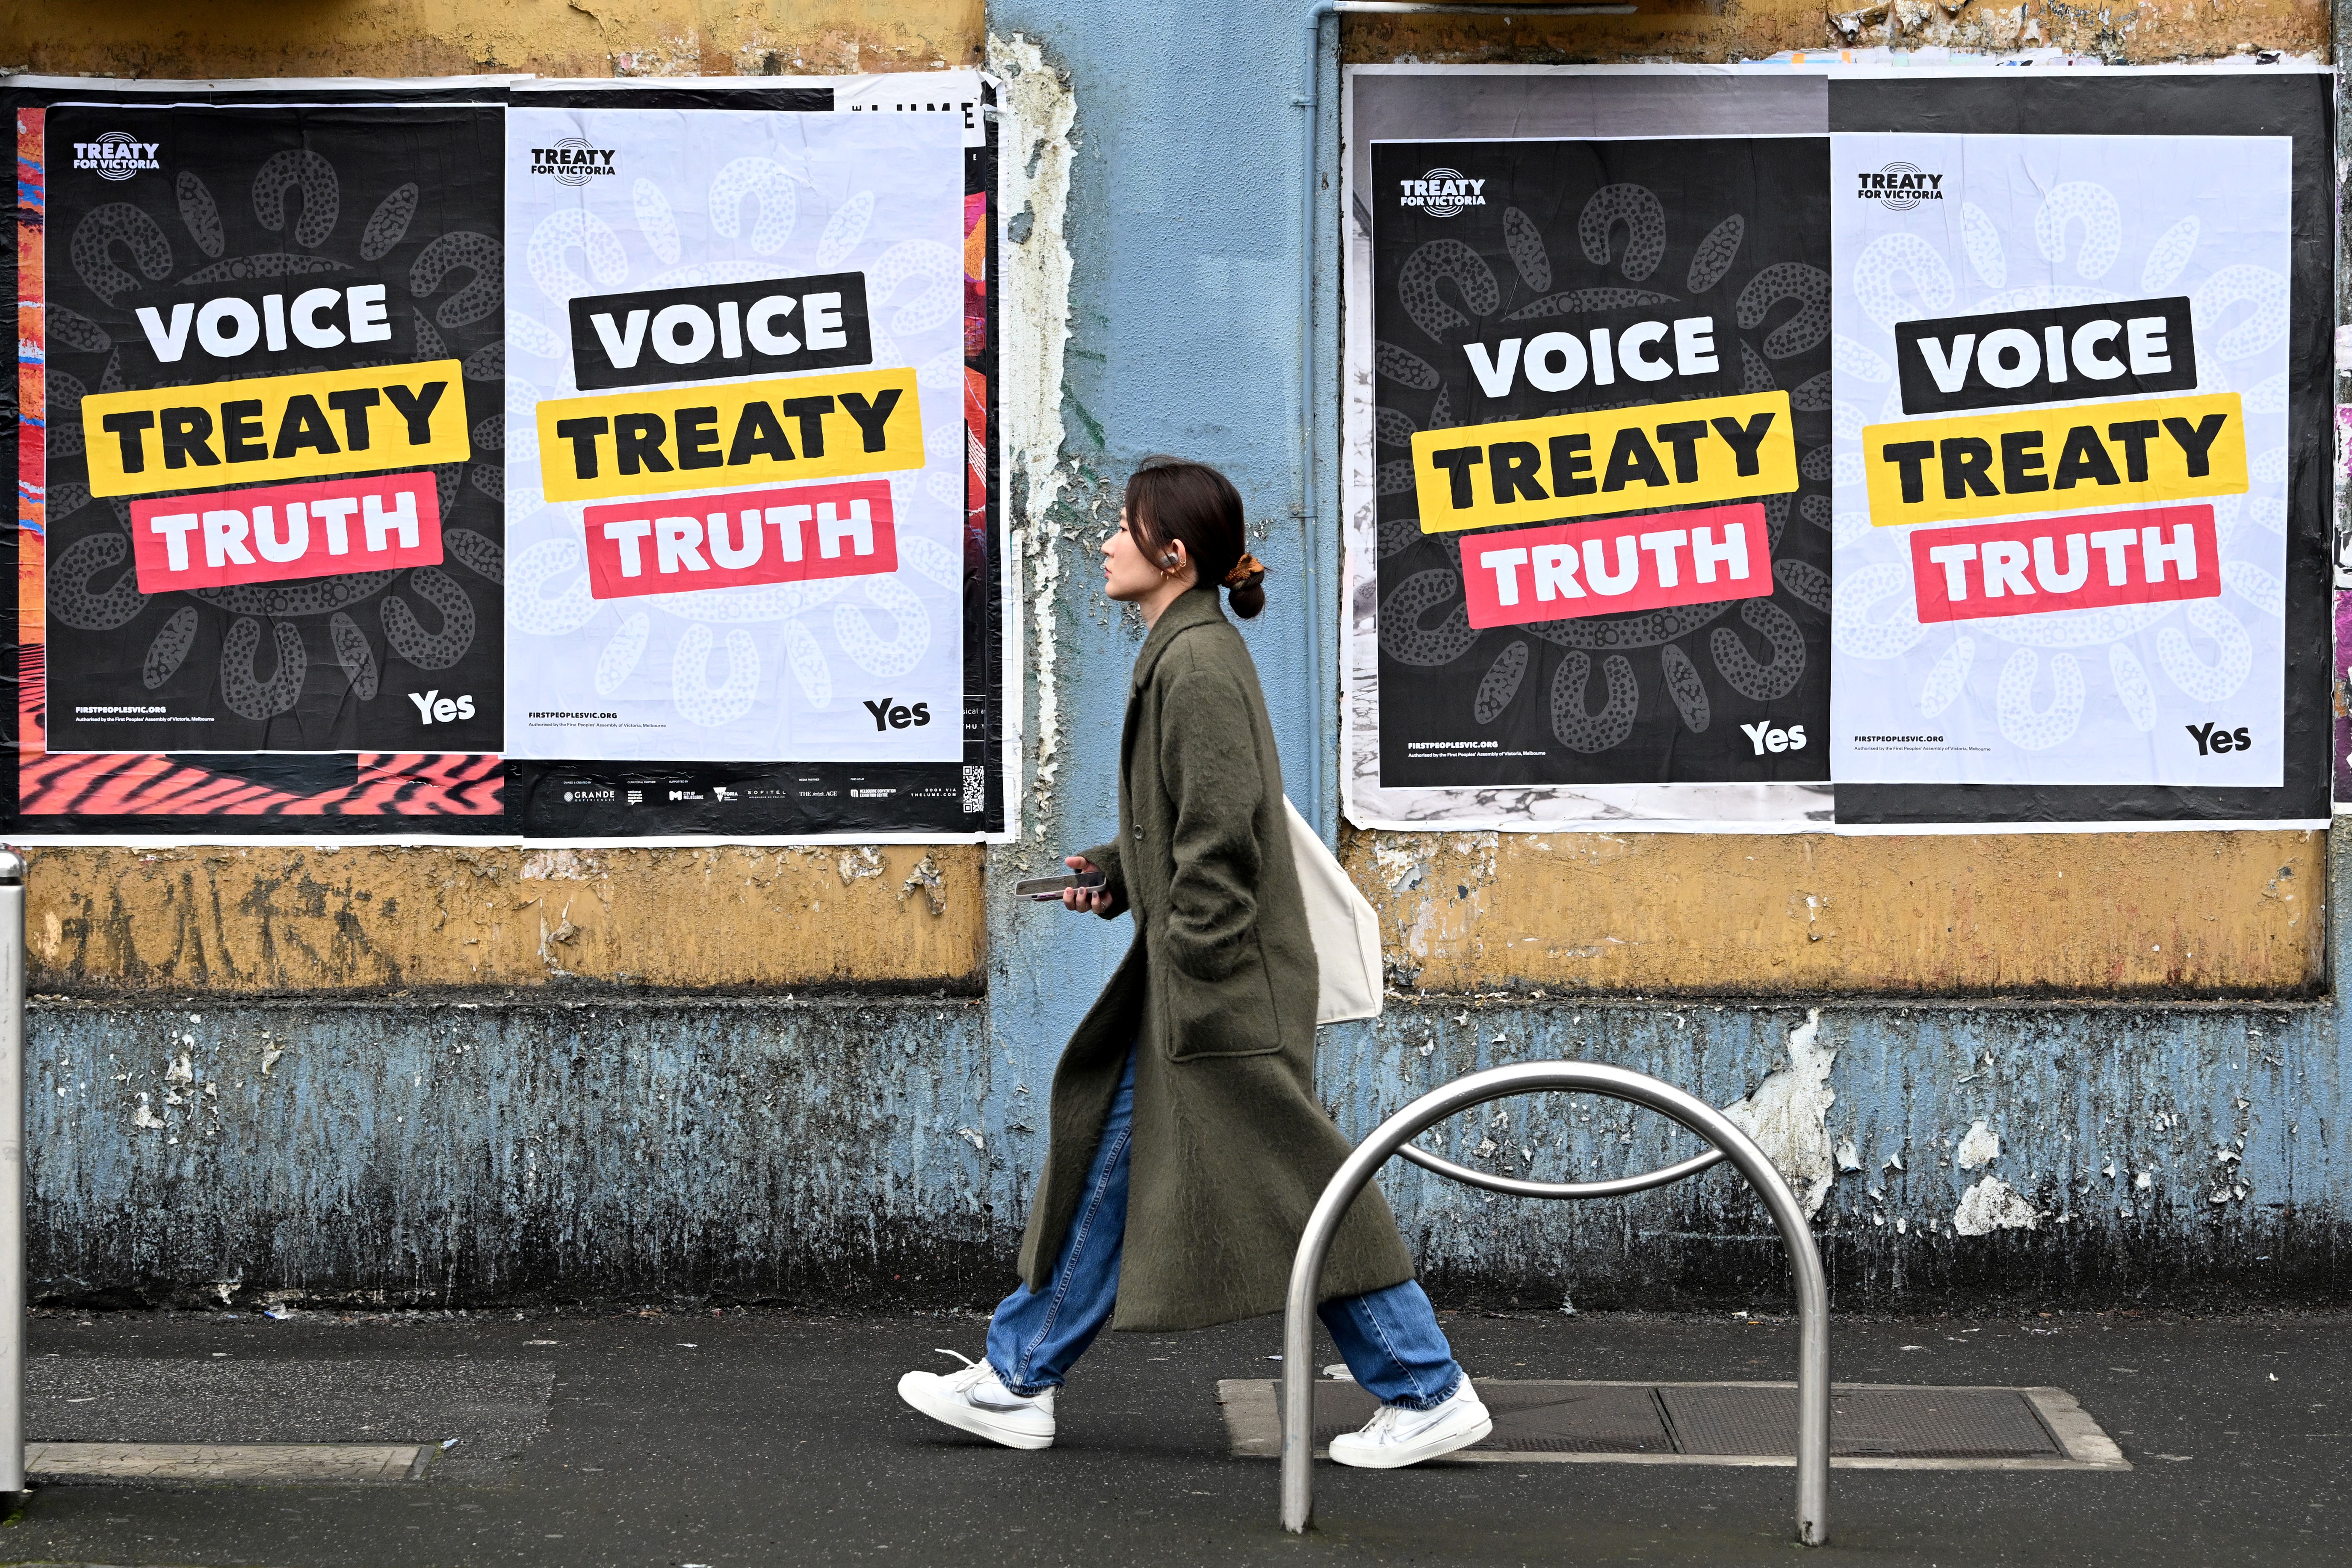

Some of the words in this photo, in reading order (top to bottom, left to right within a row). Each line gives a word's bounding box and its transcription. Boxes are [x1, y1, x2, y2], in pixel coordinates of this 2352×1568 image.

[74, 143, 160, 159] TREATY
[74, 159, 98, 169] FOR
[100, 159, 160, 169] VICTORIA
[532, 149, 616, 165] TREATY
[532, 165, 555, 174] FOR
[557, 165, 616, 175] VICTORIA
[1859, 173, 1943, 189] TREATY
[1401, 180, 1486, 196] TREATY
[1401, 197, 1424, 206] FOR
[1426, 196, 1486, 206] VICTORIA
[1859, 190, 1881, 199] FOR
[1884, 190, 1943, 200] VICTORIA
[135, 284, 391, 363] VOICE
[590, 292, 847, 369] VOICE
[1463, 316, 1719, 398] VOICE
[1917, 316, 2172, 393] VOICE
[103, 381, 448, 474] TREATY
[557, 389, 903, 479] TREATY
[1433, 412, 1775, 509] TREATY
[1883, 414, 2228, 503] TREATY
[151, 491, 420, 571] TRUTH
[604, 499, 874, 577] TRUTH
[1480, 523, 1749, 606] TRUTH
[1930, 524, 2198, 601] TRUTH
[408, 690, 475, 725] Yes
[863, 697, 931, 732] Yes
[1408, 741, 1498, 749] FIRSTPEOPLESVIC.ORG
[1740, 721, 1807, 756] Yes
[2185, 722, 2252, 756] Yes
